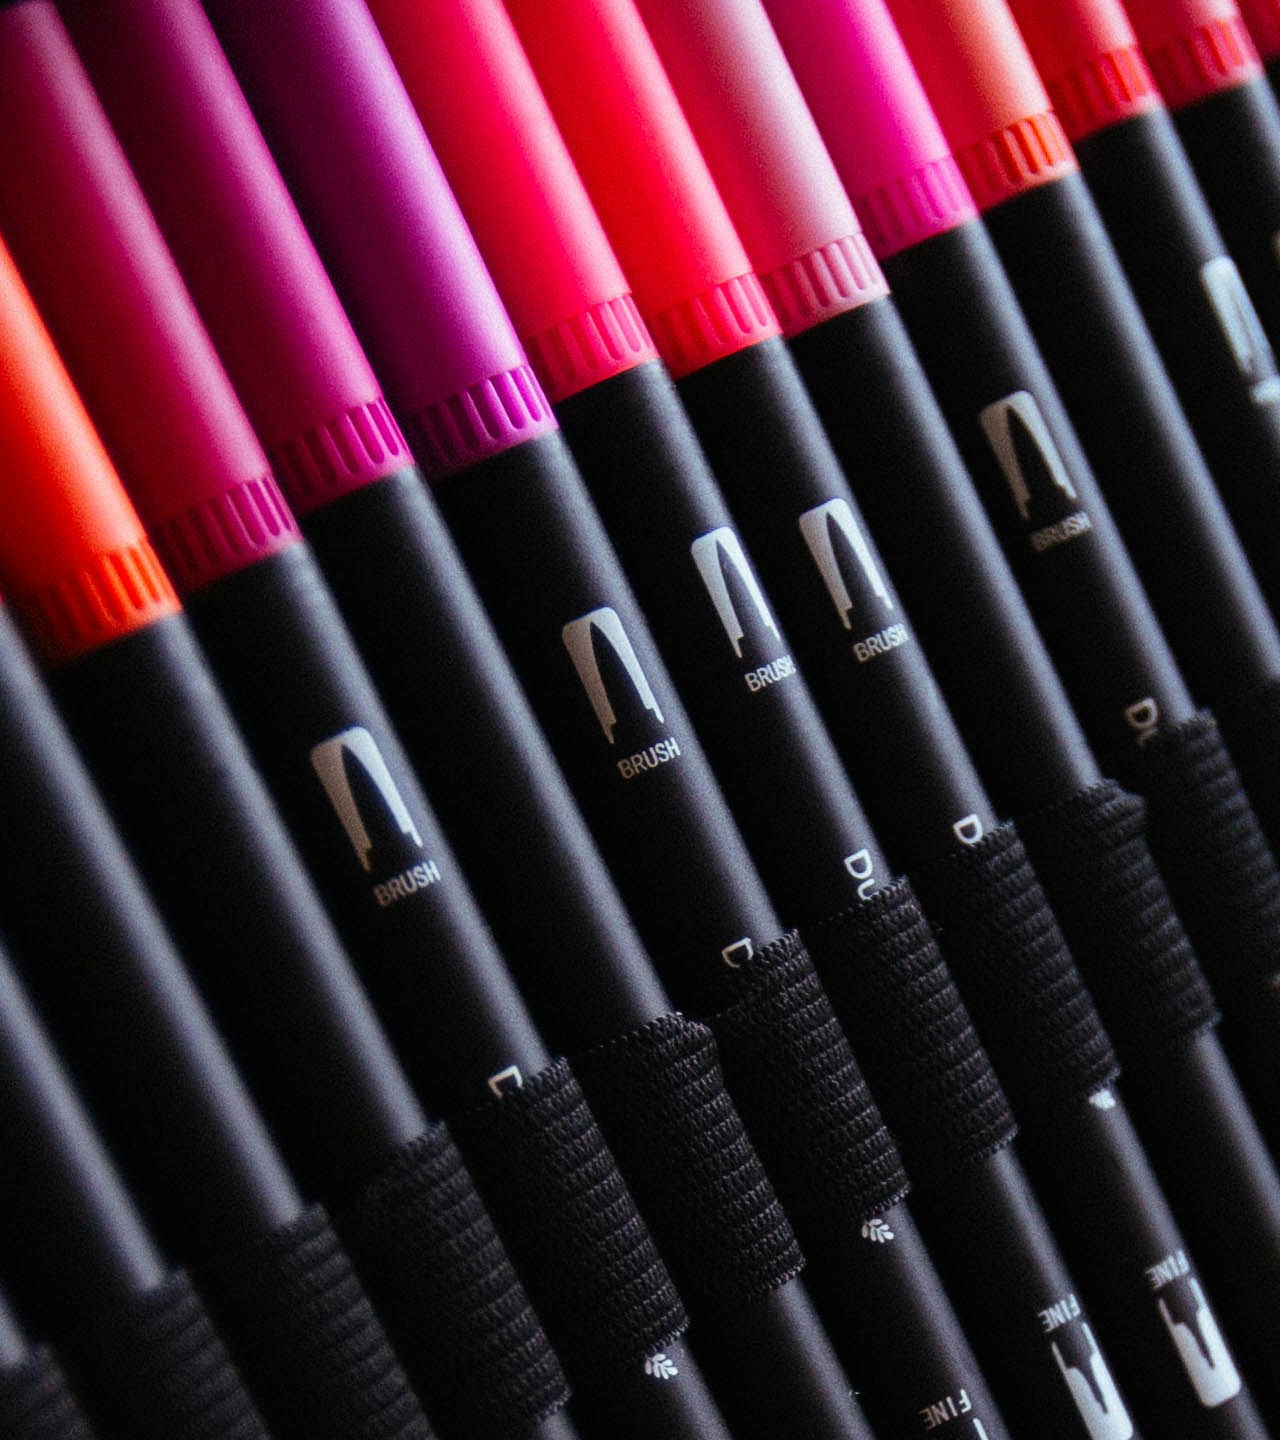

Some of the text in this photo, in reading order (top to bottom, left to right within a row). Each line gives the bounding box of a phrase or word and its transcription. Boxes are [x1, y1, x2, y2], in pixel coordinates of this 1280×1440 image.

[852, 623, 909, 664] BRUSH
[744, 654, 796, 693] BRUSH
[616, 737, 681, 781] BRUSH
[373, 861, 441, 907] BRUSH
[1037, 1292, 1082, 1335] FINE
[917, 1387, 972, 1432] FINE
